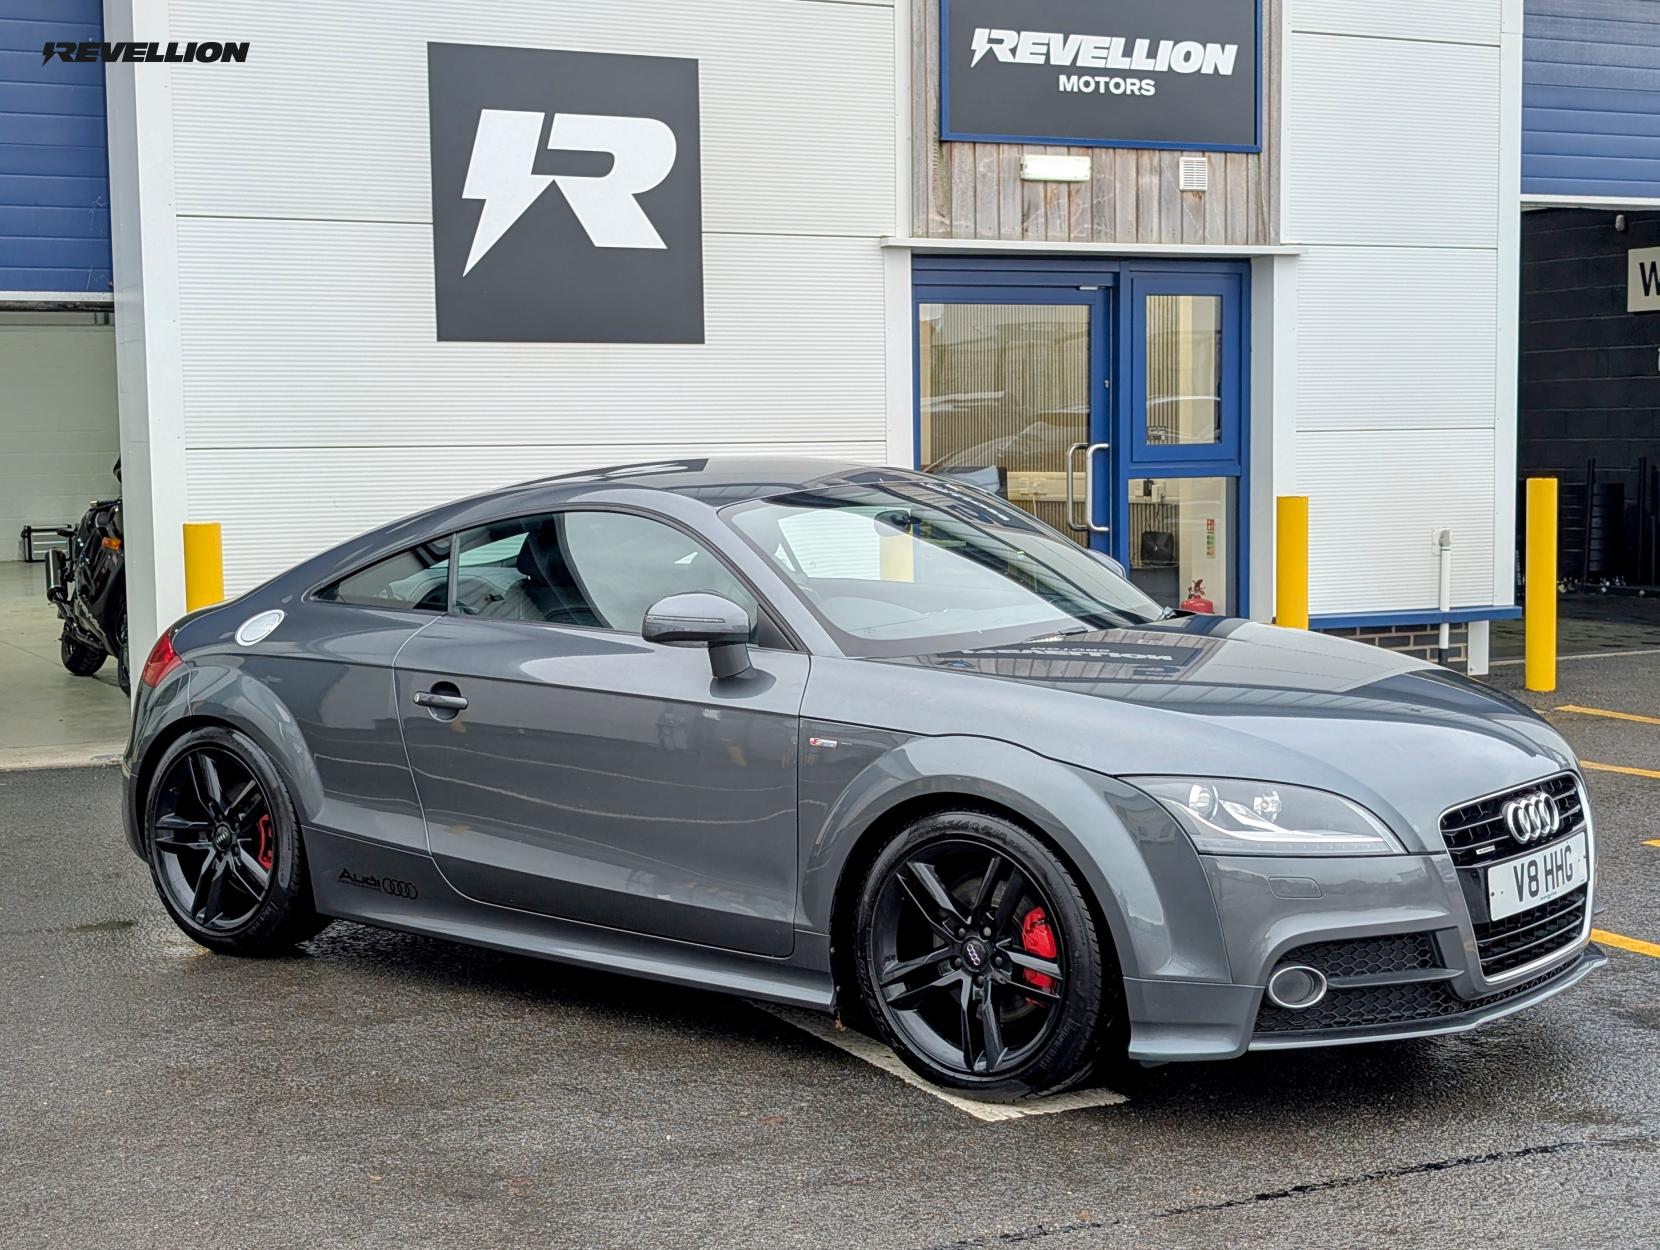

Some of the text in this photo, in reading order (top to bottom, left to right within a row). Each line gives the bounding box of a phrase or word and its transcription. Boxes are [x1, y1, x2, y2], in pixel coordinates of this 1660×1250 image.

[971, 28, 1238, 75] REVELLION
[1059, 75, 1156, 96] MOTORS
[1513, 845, 1573, 902] V8 HHG
